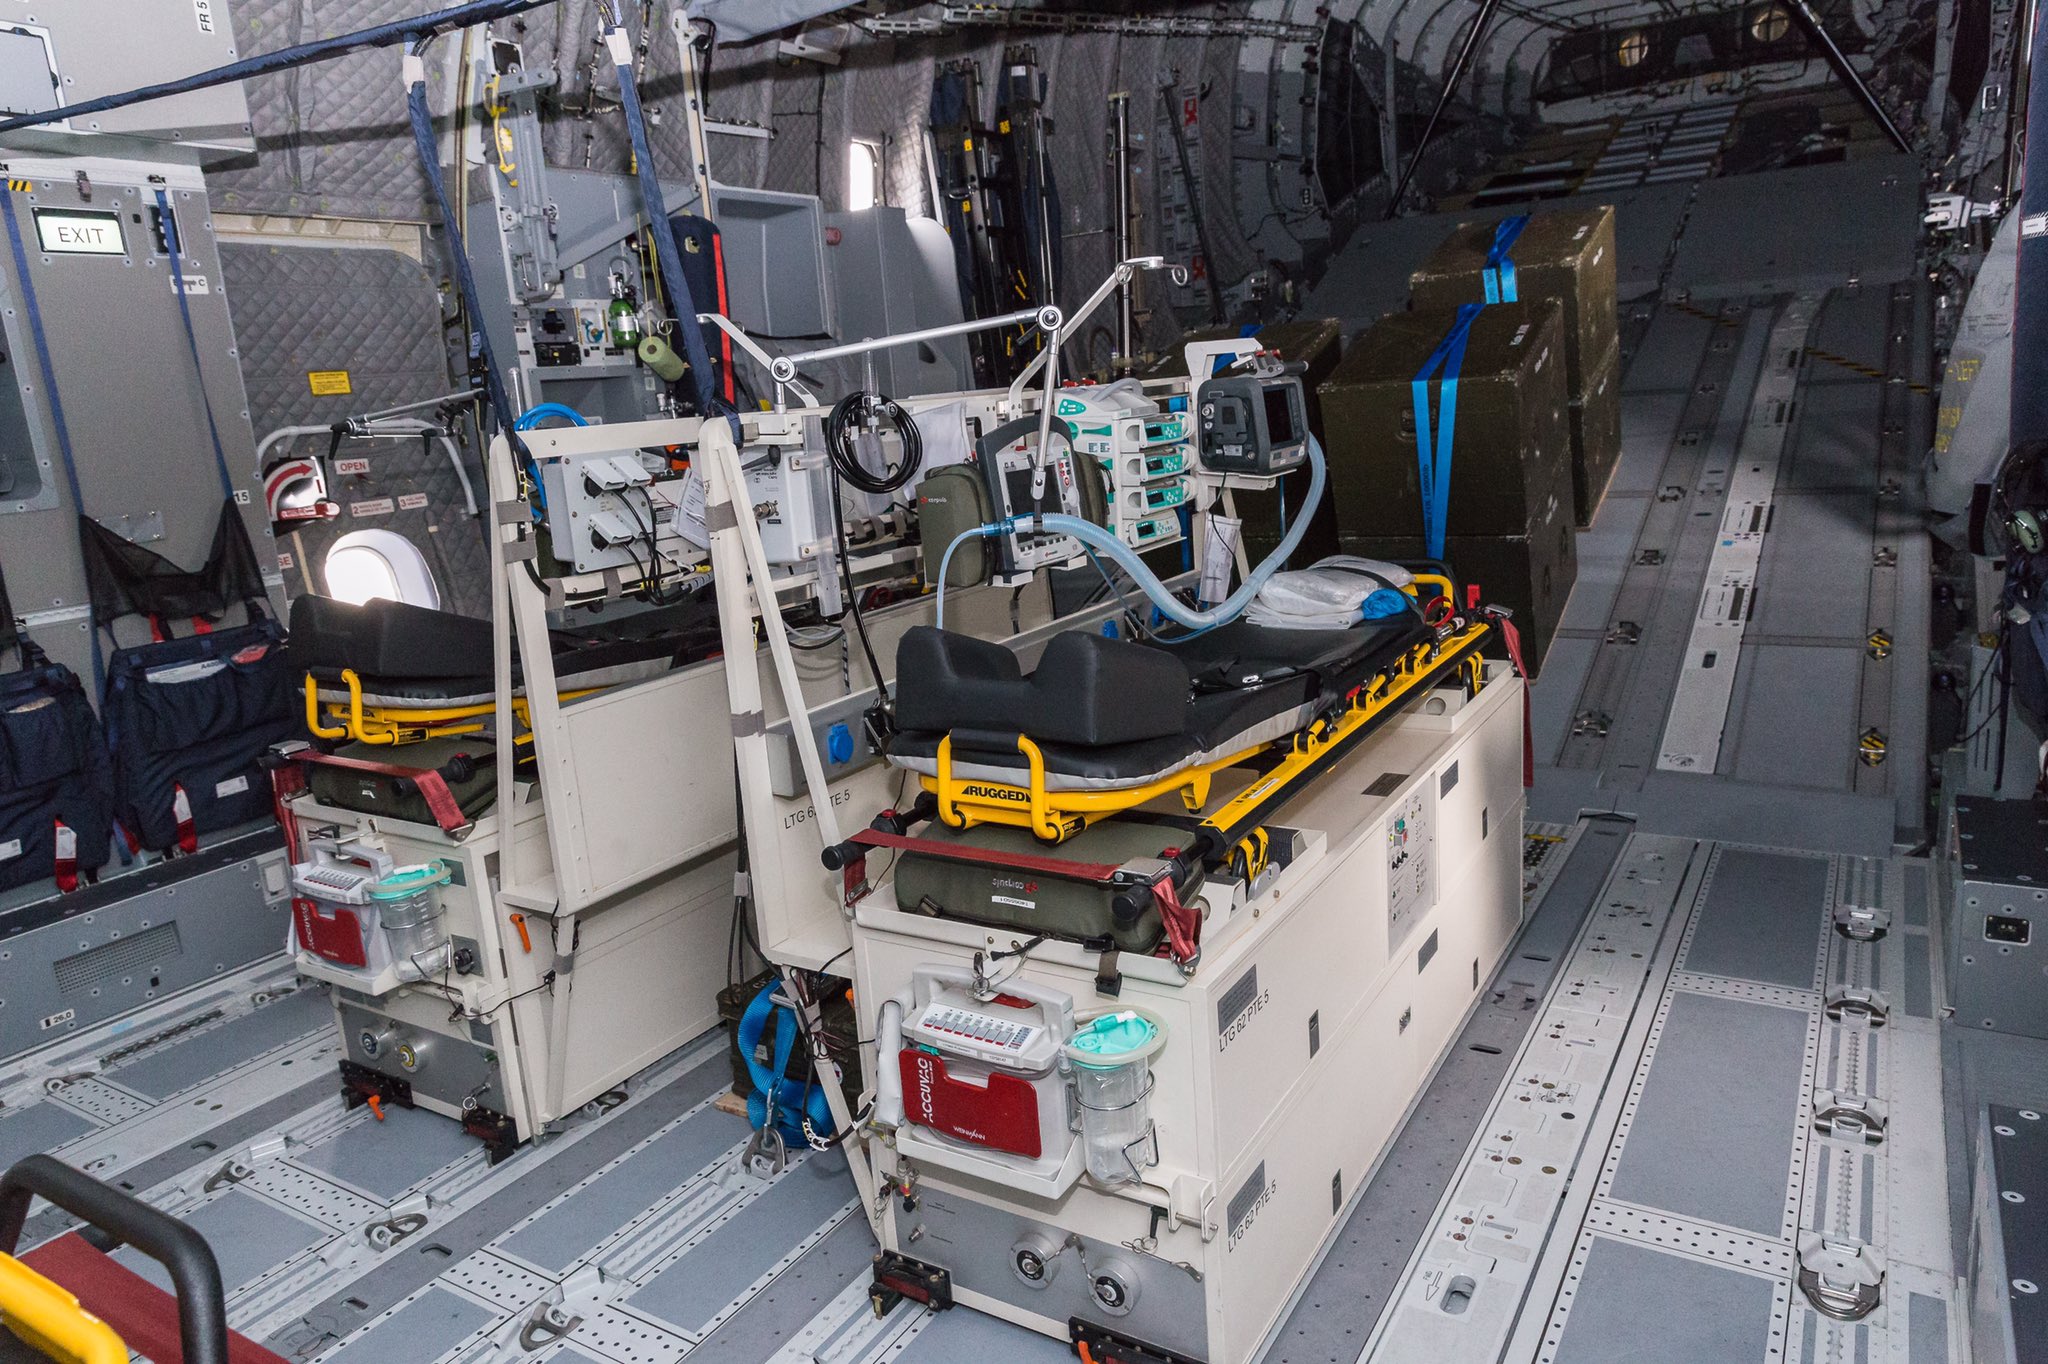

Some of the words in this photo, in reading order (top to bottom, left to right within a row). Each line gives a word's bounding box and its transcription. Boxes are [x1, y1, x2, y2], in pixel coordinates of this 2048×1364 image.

[199, 13, 212, 32] FR
[57, 226, 104, 244] EXIT
[339, 461, 366, 472] OPEN
[353, 504, 360, 514] 2
[400, 498, 407, 507] 3
[968, 785, 1025, 802] RUGGED
[784, 810, 806, 830] LTG
[807, 805, 817, 818] 6
[844, 788, 851, 801] 5
[52, 1011, 72, 1024] 26.0
[1219, 1025, 1236, 1053] LTG
[1236, 1013, 1247, 1034] 62
[1247, 995, 1263, 1022] PTE
[1264, 988, 1270, 1004] 5
[917, 1057, 934, 1123] ACCUVAC
[1228, 1224, 1244, 1254] LTG
[1244, 1209, 1255, 1230] 62
[1255, 1186, 1270, 1217] PTE
[1271, 1178, 1277, 1194] 5
